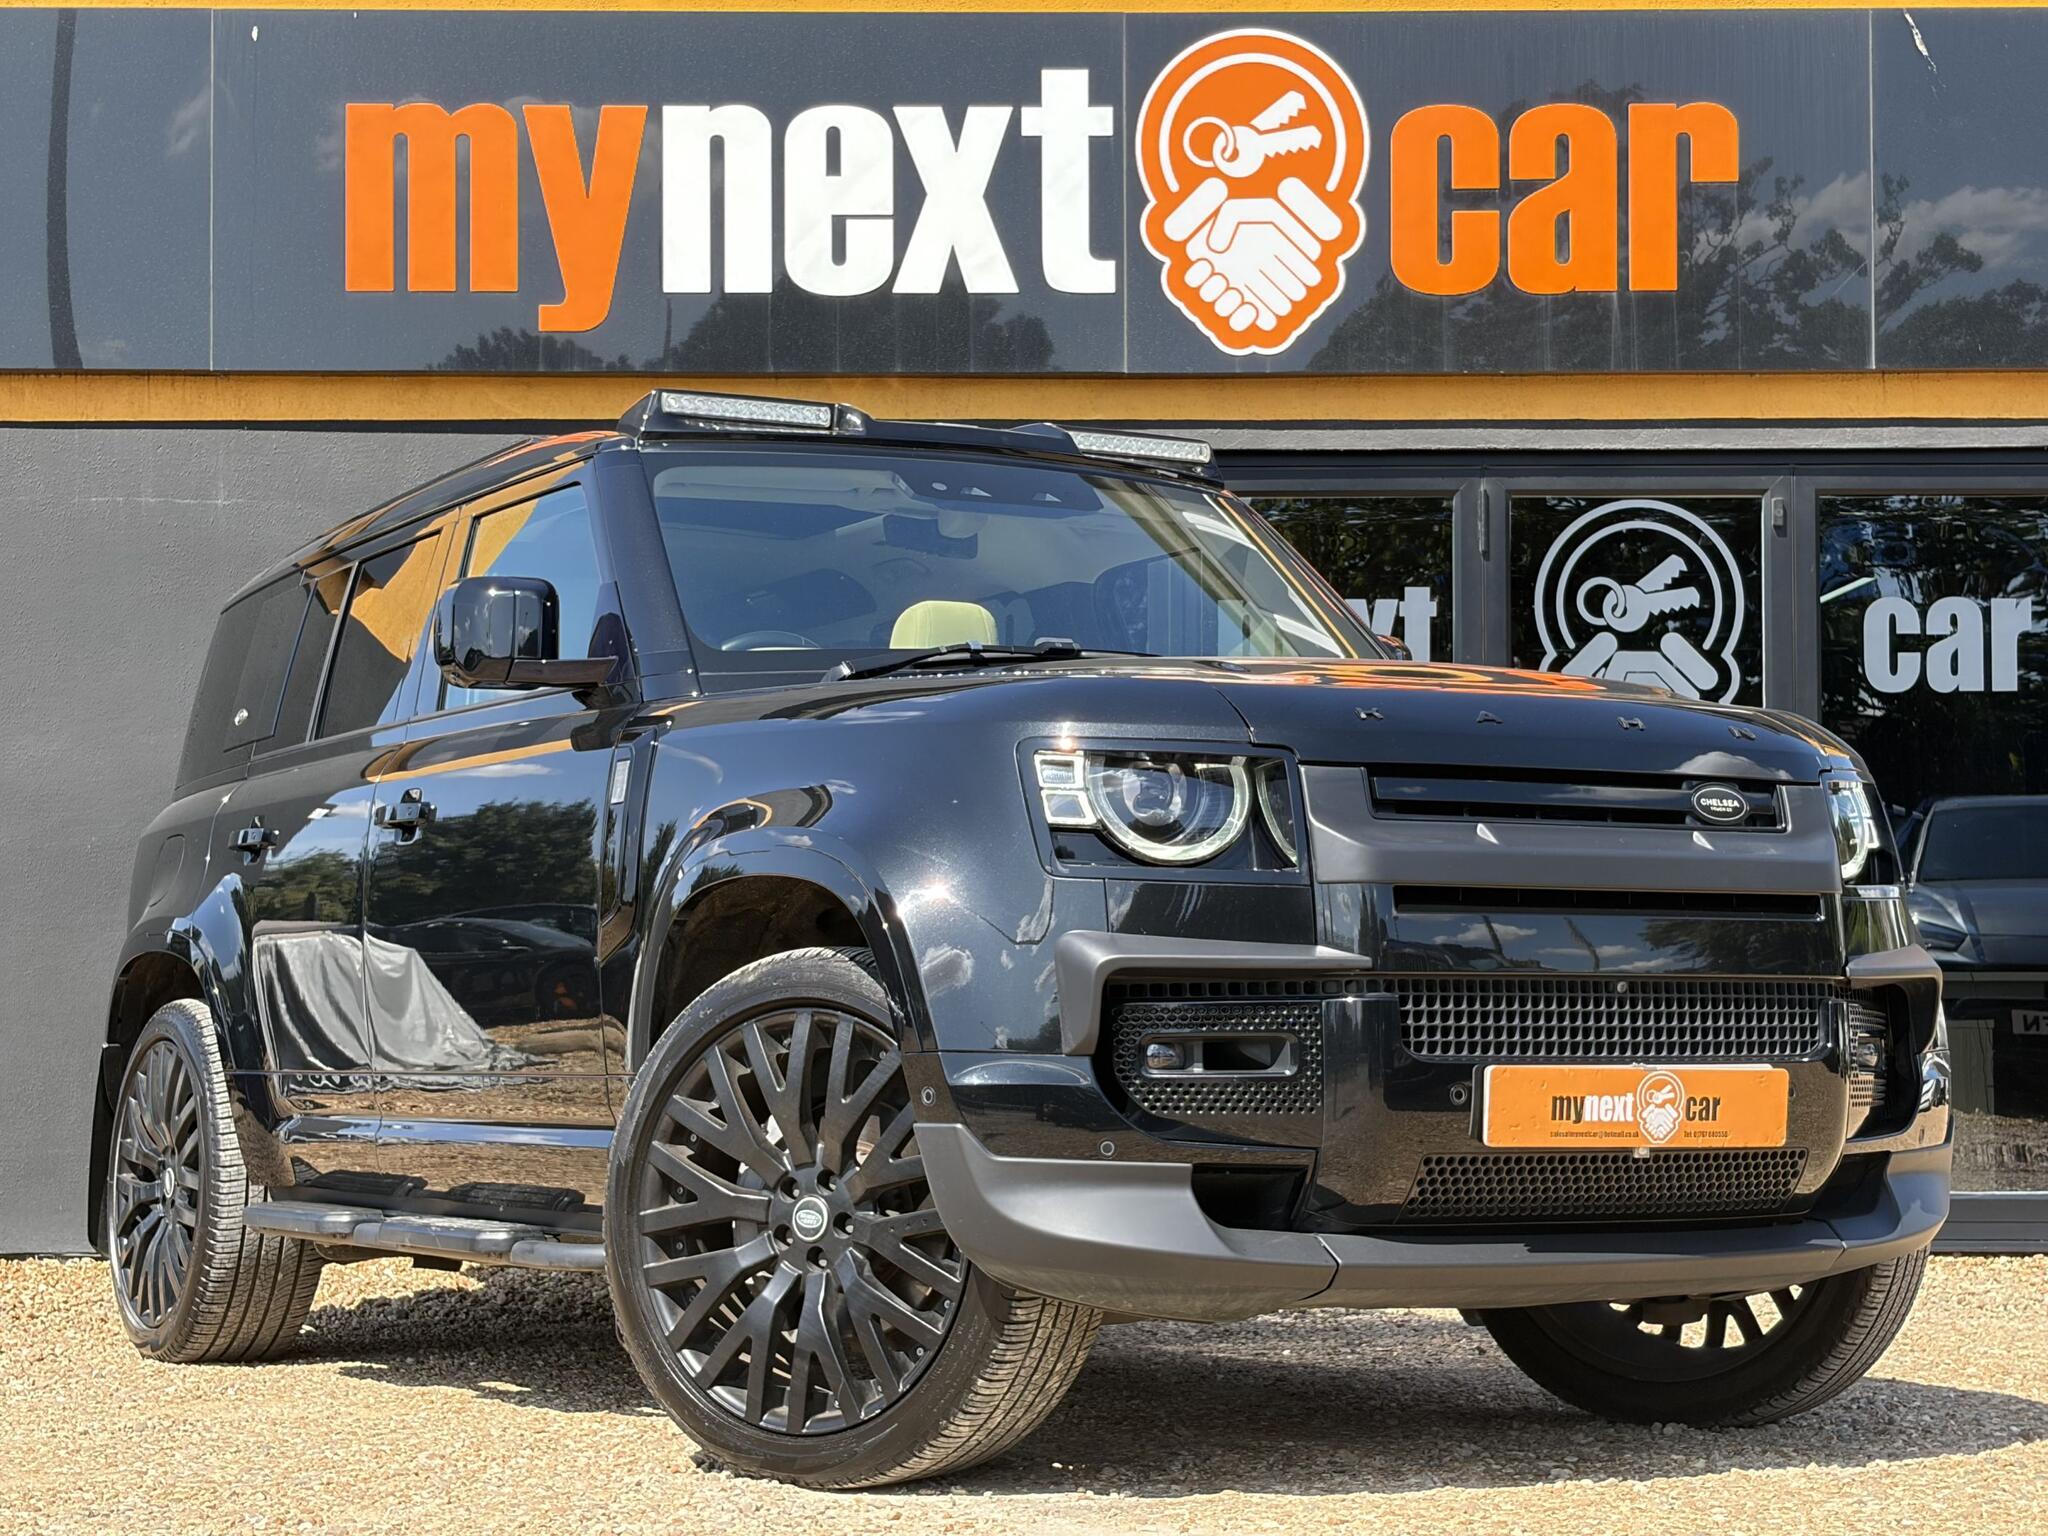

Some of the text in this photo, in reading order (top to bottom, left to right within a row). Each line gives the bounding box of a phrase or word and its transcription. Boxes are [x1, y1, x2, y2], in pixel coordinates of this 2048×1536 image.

[1390, 102, 1740, 296] car
[1863, 596, 2033, 694] car
[1700, 797, 1740, 808] CHELSEA
[1685, 1096, 1721, 1122] car
